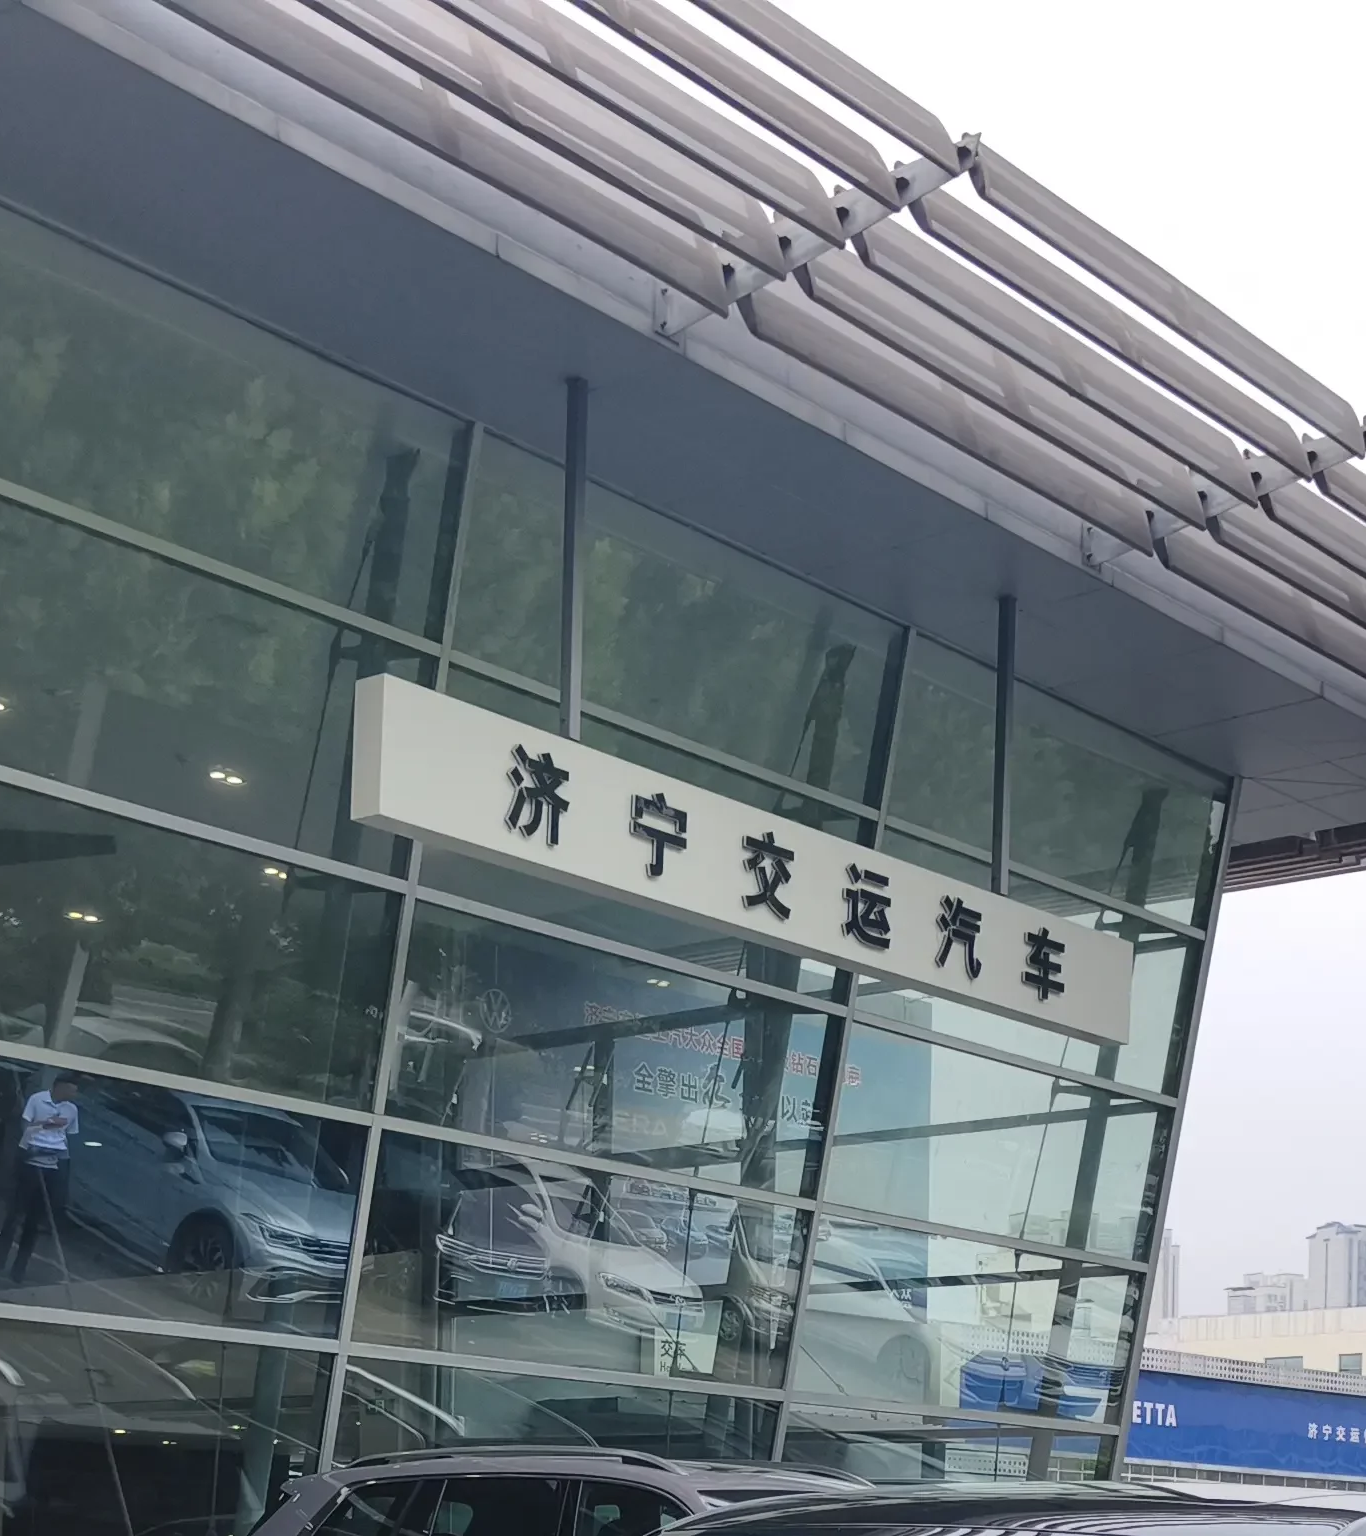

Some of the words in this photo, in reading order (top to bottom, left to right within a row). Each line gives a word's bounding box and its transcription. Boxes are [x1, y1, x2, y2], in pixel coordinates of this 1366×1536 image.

[505, 743, 1065, 1000] 济宁交运汽车
